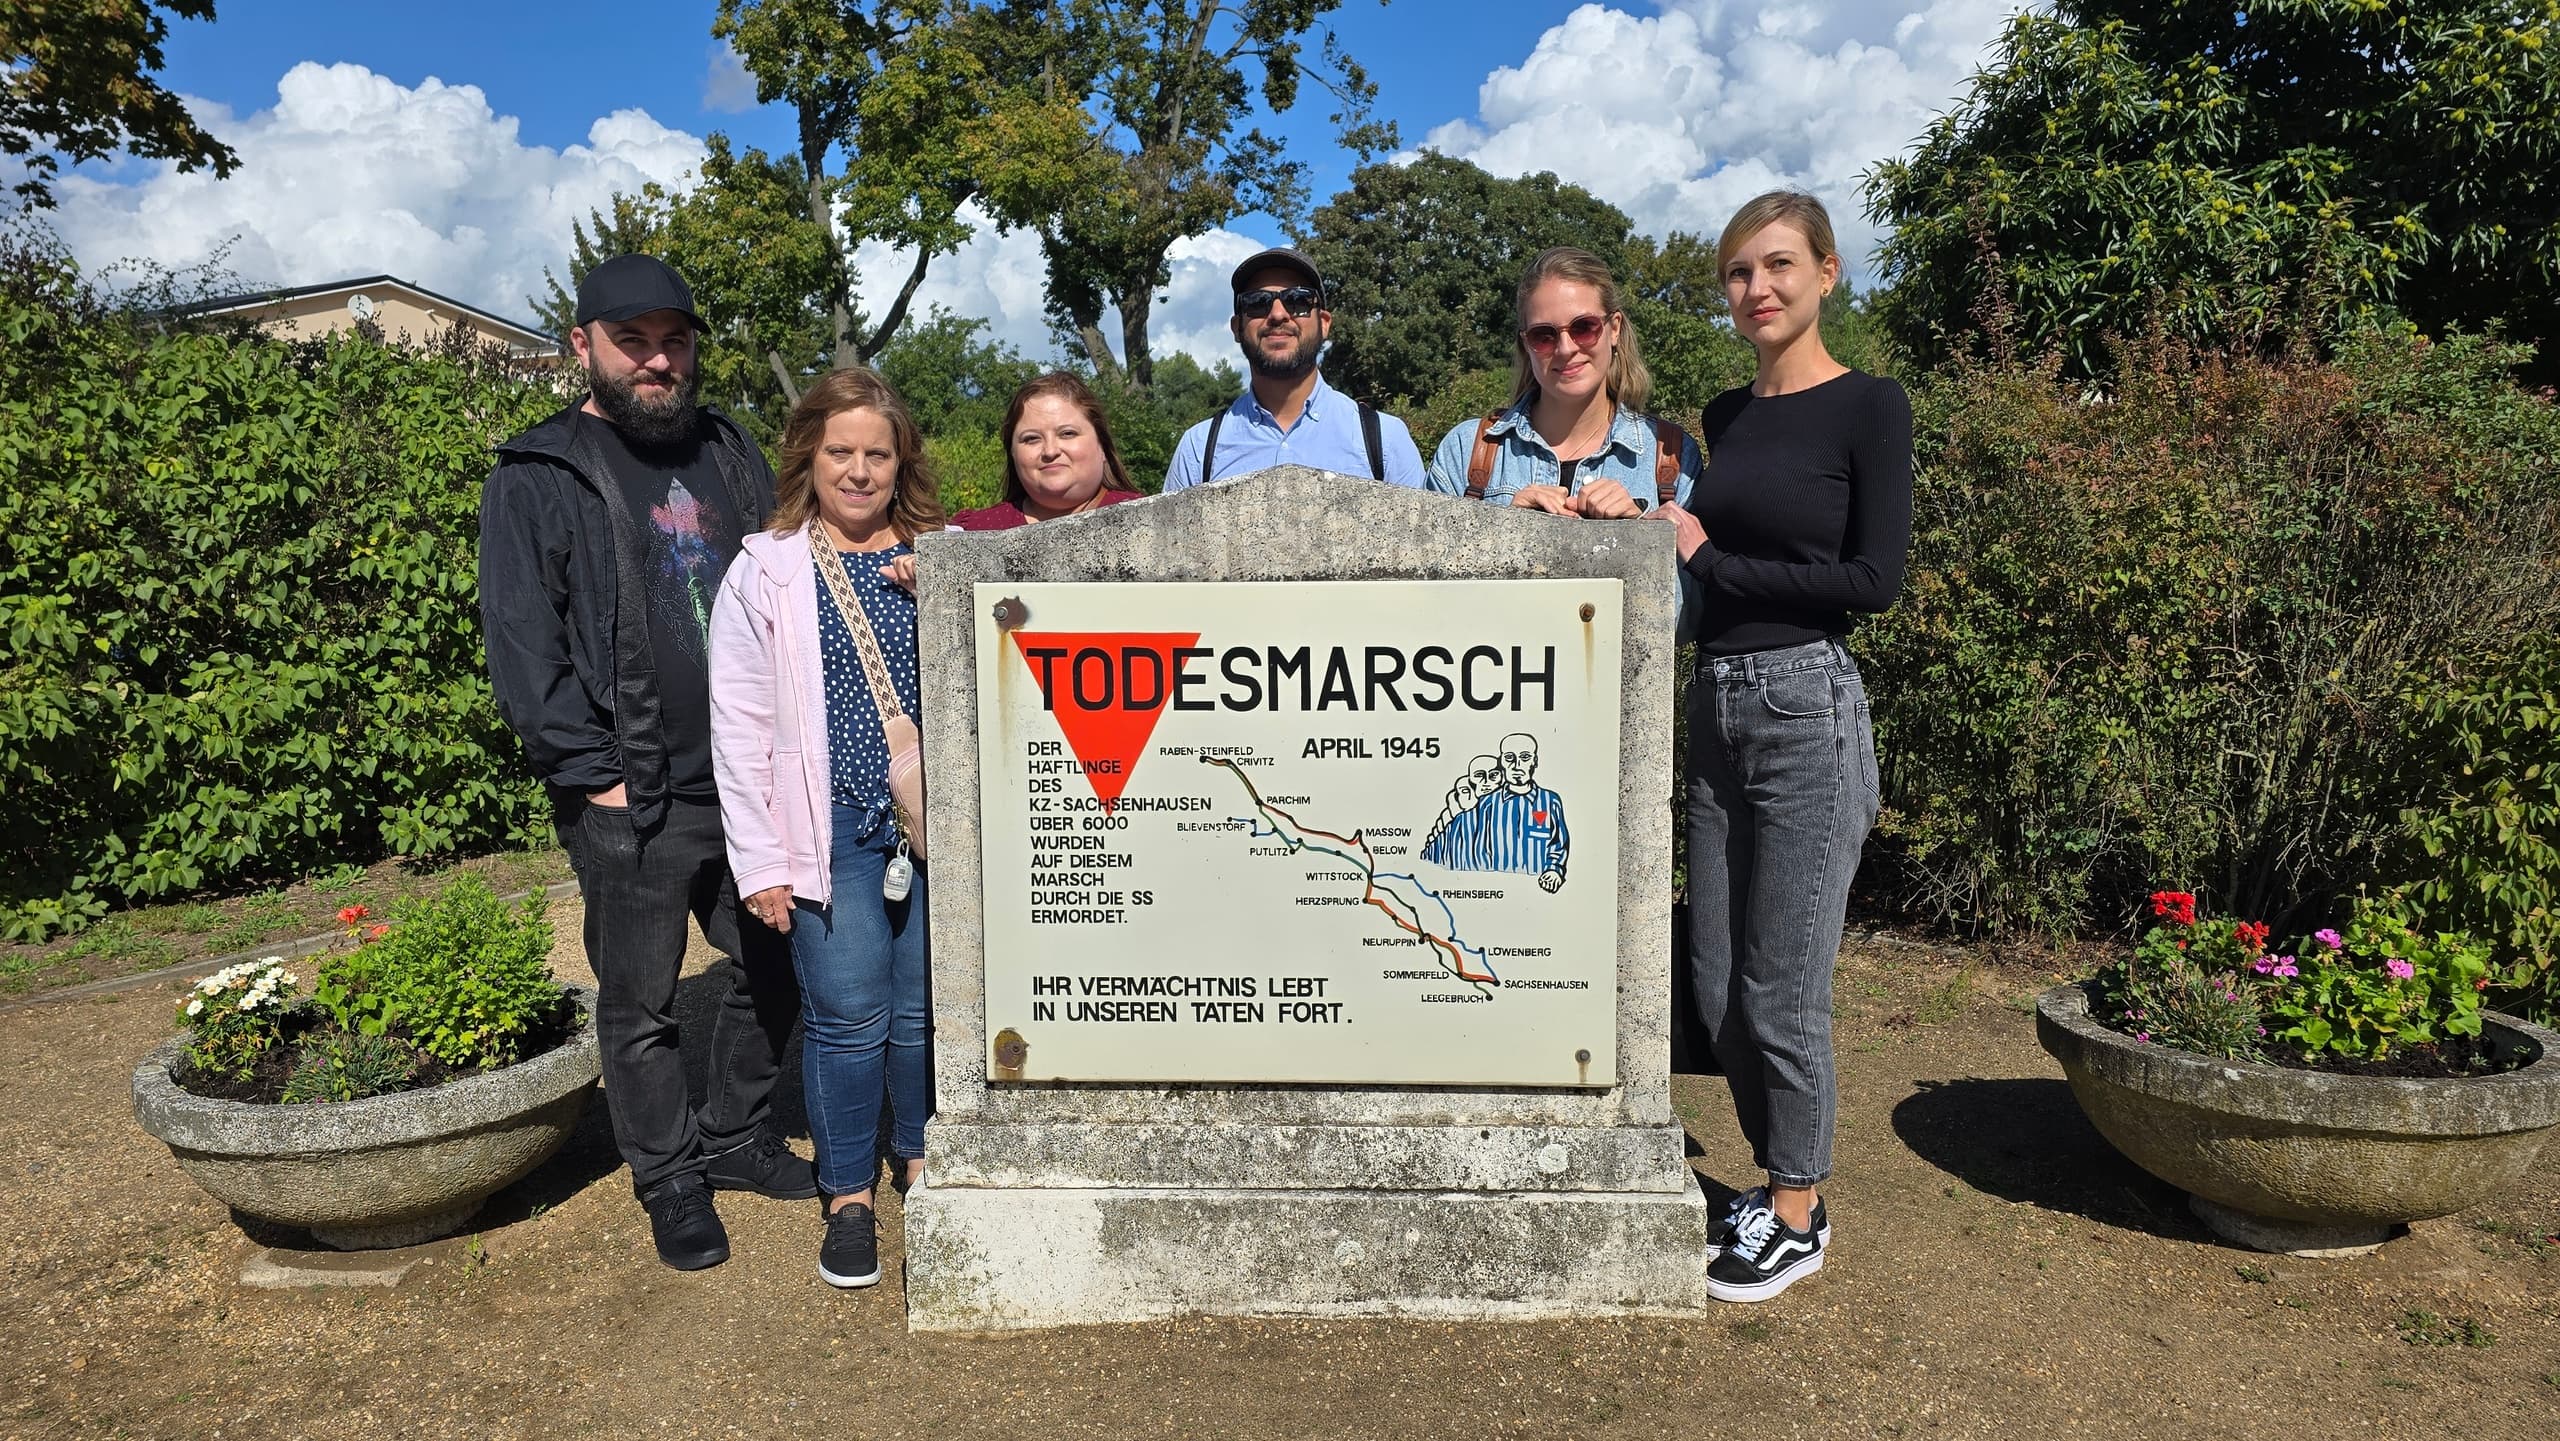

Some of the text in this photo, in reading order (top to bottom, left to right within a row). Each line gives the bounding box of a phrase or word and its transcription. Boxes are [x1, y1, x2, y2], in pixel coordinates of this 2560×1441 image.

[1026, 645, 1555, 712] TODESMARSCH
[1028, 741, 1062, 756] DER
[1160, 747, 1253, 756] RABEN-STEINFELD
[1302, 737, 1440, 759] APRIL 1945
[1028, 759, 1121, 774] HÄFTLINGE
[1236, 758, 1274, 766] CRIVITZ
[1029, 779, 1062, 793] DES
[1029, 797, 1211, 811] KZ-SACHSENHAUSEN
[1266, 796, 1310, 805] PARCHIM
[1030, 816, 1128, 831] ÜBER 6000
[1177, 823, 1246, 832] BLIEVENSTORF
[1366, 828, 1411, 837] MASSOW
[1031, 836, 1104, 849] WURDEN
[1250, 848, 1288, 856] PUTLITZ
[1373, 846, 1407, 855] BELOW
[1031, 854, 1132, 868] AUF DIESEM
[1031, 873, 1104, 886] MARSCH
[1306, 872, 1363, 881] WITTSTOCK
[1031, 891, 1153, 905] DURCH DIE SS
[1443, 890, 1504, 899] RHEINSBERG
[1296, 897, 1359, 906] HERZSPRUNG
[1031, 910, 1127, 924] ERMORDET.
[1363, 938, 1416, 947] NEURUPPIN
[1383, 970, 1449, 980] SOMMERFELD
[1033, 976, 1328, 998] IHR VERMÄCHTNIS LEBT
[1504, 980, 1588, 989] SACHSENHAUSEN
[1421, 994, 1484, 1003] LEEGEBRUCH
[1033, 1002, 1055, 1021] IN
[1067, 1002, 1177, 1022] UNSEREN
[1191, 1002, 1264, 1023] TATEN
